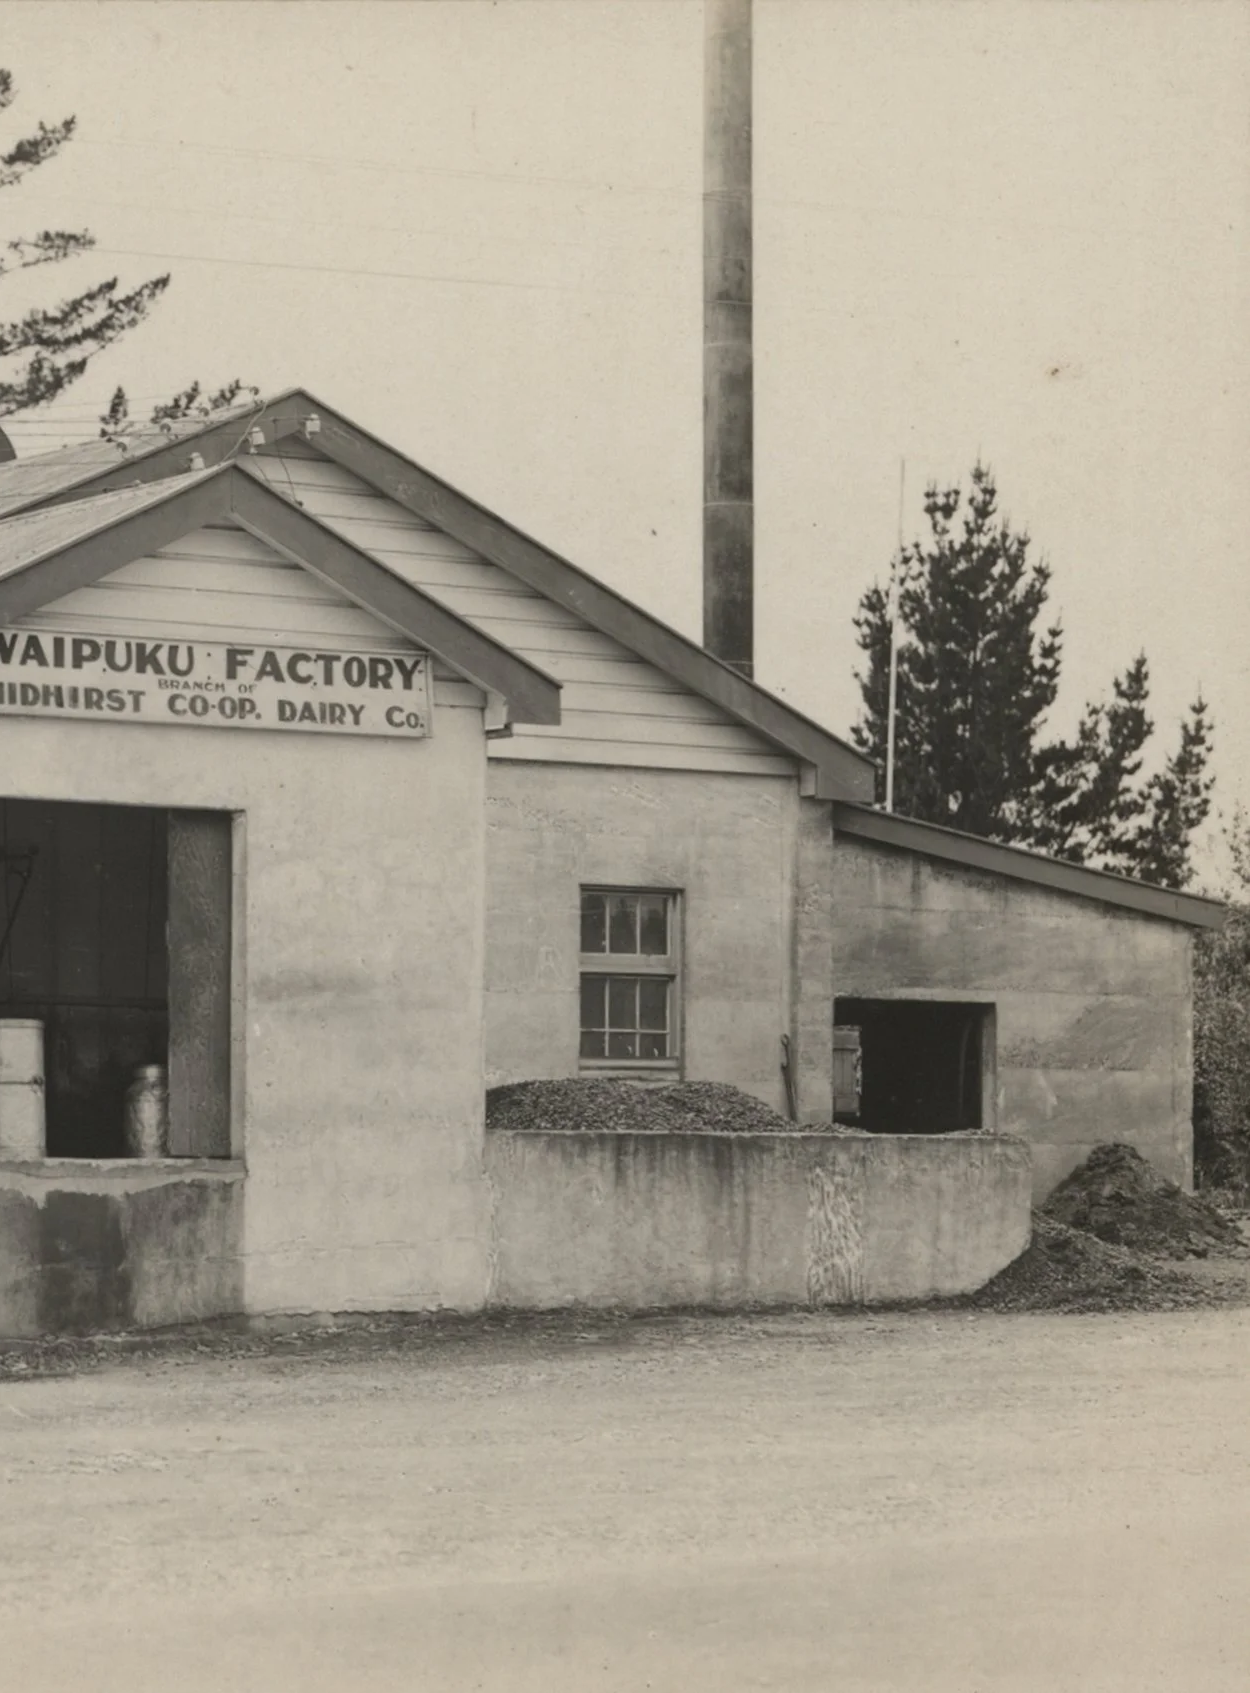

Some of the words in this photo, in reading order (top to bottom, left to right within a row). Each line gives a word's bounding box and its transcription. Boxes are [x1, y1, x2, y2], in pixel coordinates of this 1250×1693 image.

[225, 648, 422, 690] FACTORY
[158, 678, 226, 693] BRANCH
[238, 683, 257, 694] OF
[277, 700, 365, 726] DAIRY
